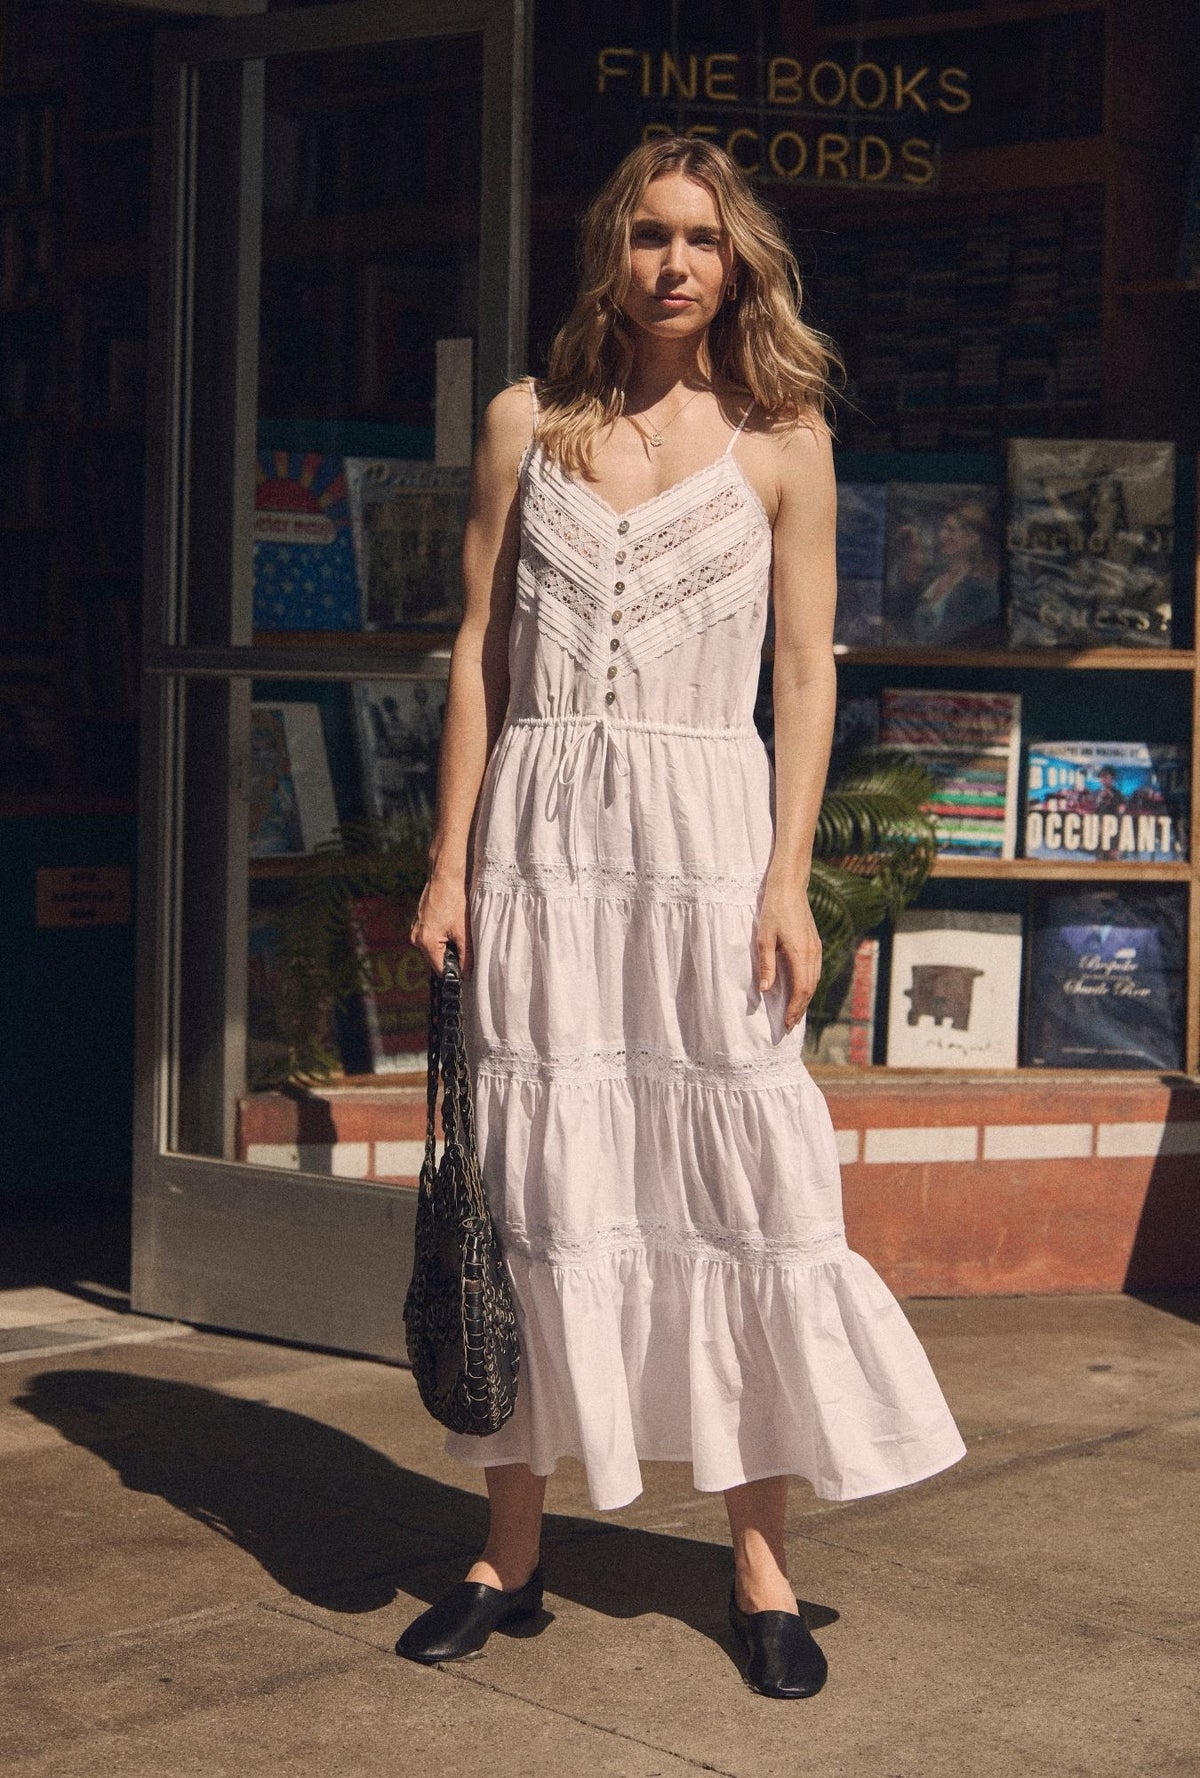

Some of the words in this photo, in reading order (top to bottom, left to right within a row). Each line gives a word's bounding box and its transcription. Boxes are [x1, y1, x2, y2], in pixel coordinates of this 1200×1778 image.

[596, 46, 741, 101] FINE
[767, 55, 973, 115] BOOKS
[640, 122, 936, 186] CORDS
[1026, 811, 1173, 853] OCCUPANT
